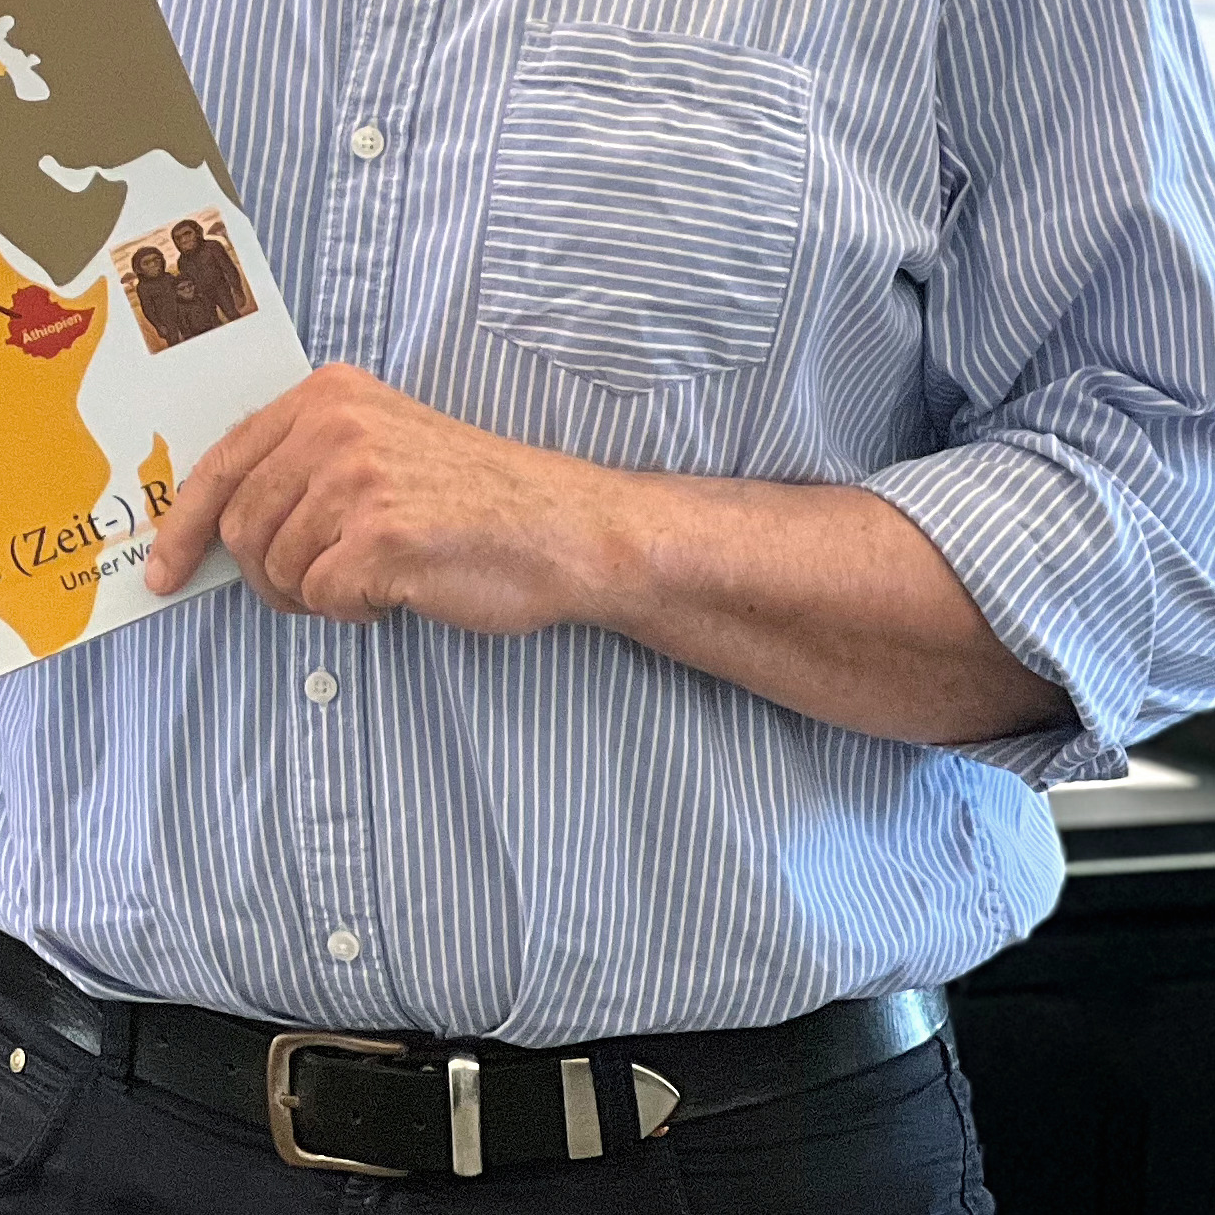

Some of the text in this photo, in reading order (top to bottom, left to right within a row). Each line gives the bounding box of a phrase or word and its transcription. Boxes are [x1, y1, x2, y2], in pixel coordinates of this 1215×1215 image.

[22, 313, 83, 344] Äthiopien
[10, 495, 135, 577] (Zeit-)
[60, 558, 119, 591] Unser
